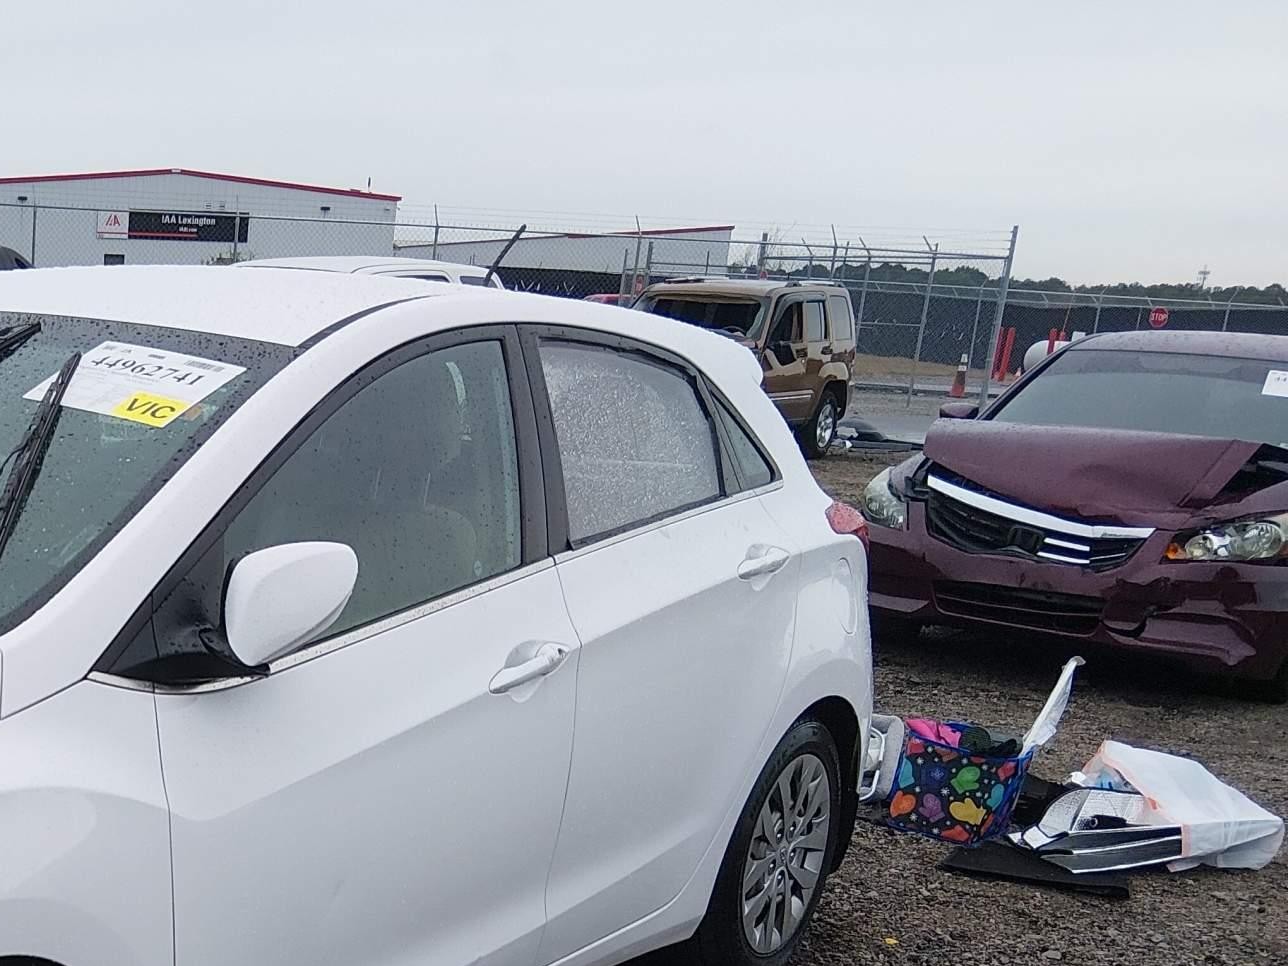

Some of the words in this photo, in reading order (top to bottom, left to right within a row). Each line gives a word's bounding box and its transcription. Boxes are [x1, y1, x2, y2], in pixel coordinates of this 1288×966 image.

[161, 214, 177, 224] IAA
[178, 215, 216, 227] Lexington
[1151, 312, 1168, 321] STOP
[91, 356, 206, 386] 44962741
[126, 397, 176, 419] VIC
